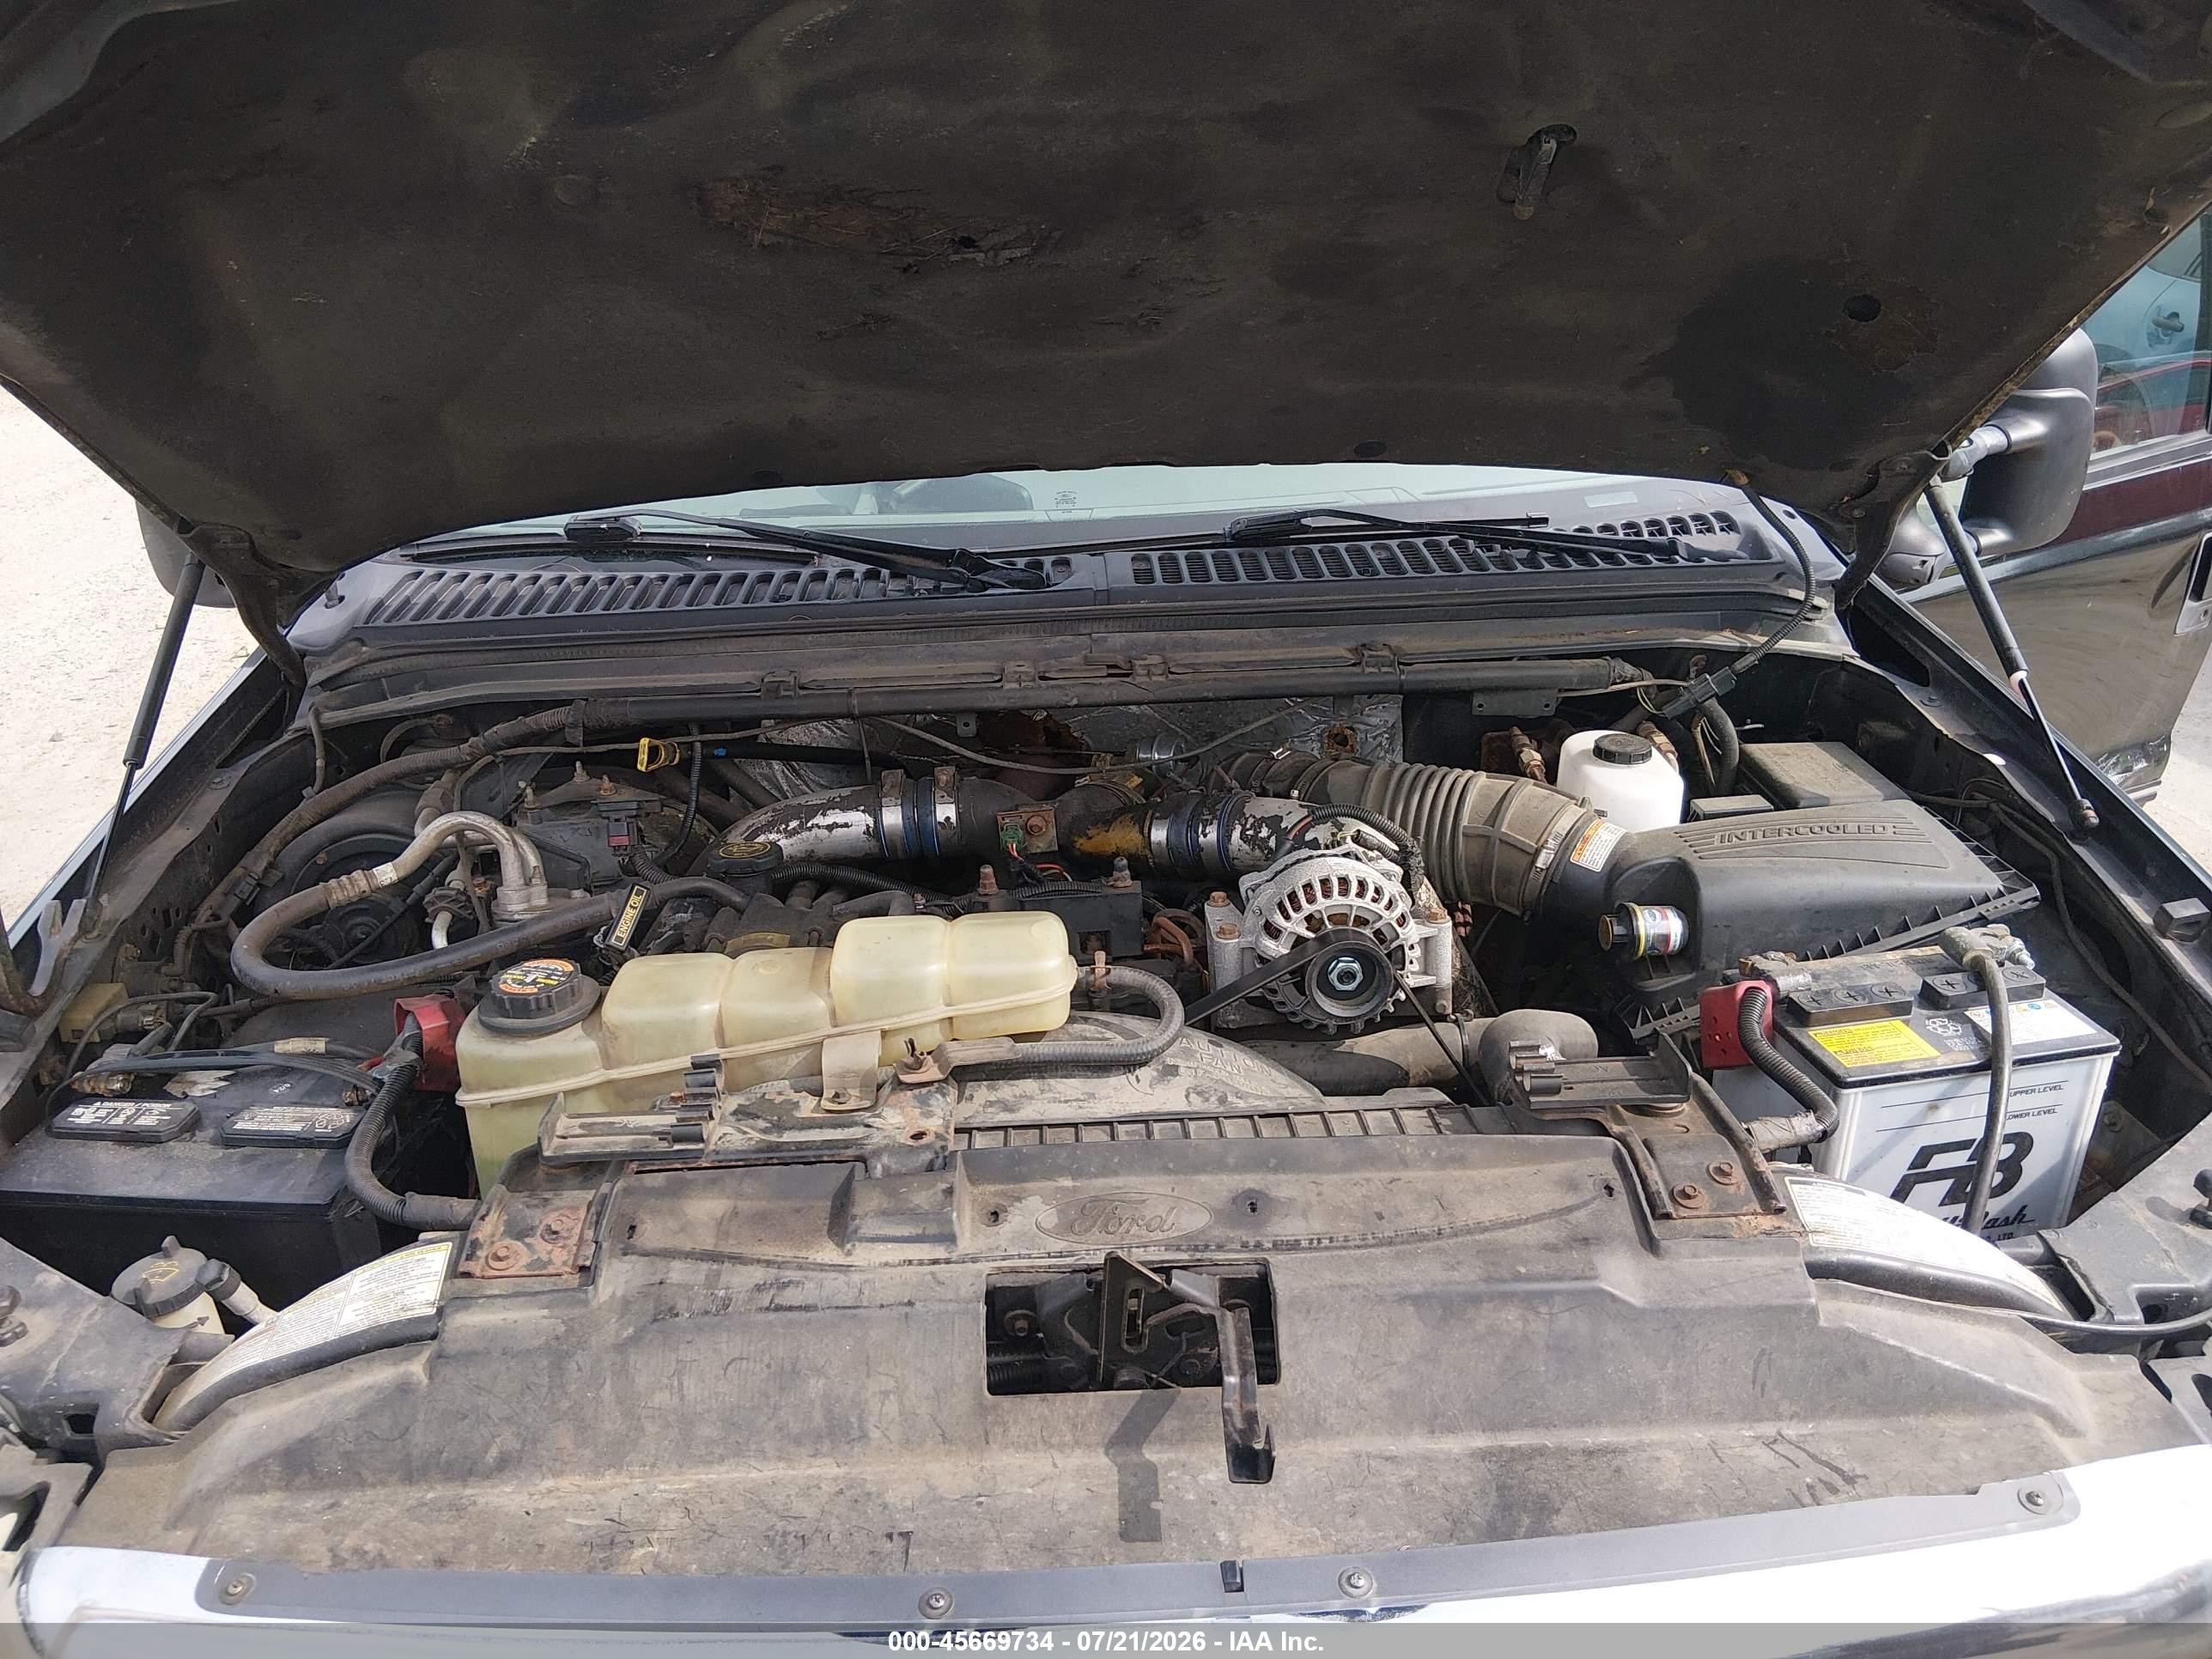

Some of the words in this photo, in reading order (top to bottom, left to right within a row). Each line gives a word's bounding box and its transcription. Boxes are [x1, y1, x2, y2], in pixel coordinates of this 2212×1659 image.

[1718, 823, 1889, 844] INTERCOOLED
[617, 907, 636, 938] ENGINE
[630, 895, 642, 908] OIL
[1179, 1037, 1272, 1077] AUTION
[1200, 1052, 1243, 1074] FAN
[2009, 1088, 2036, 1097] UPPER
[2038, 1085, 2063, 1093] LEVEL
[1070, 1198, 1177, 1237] Ford
